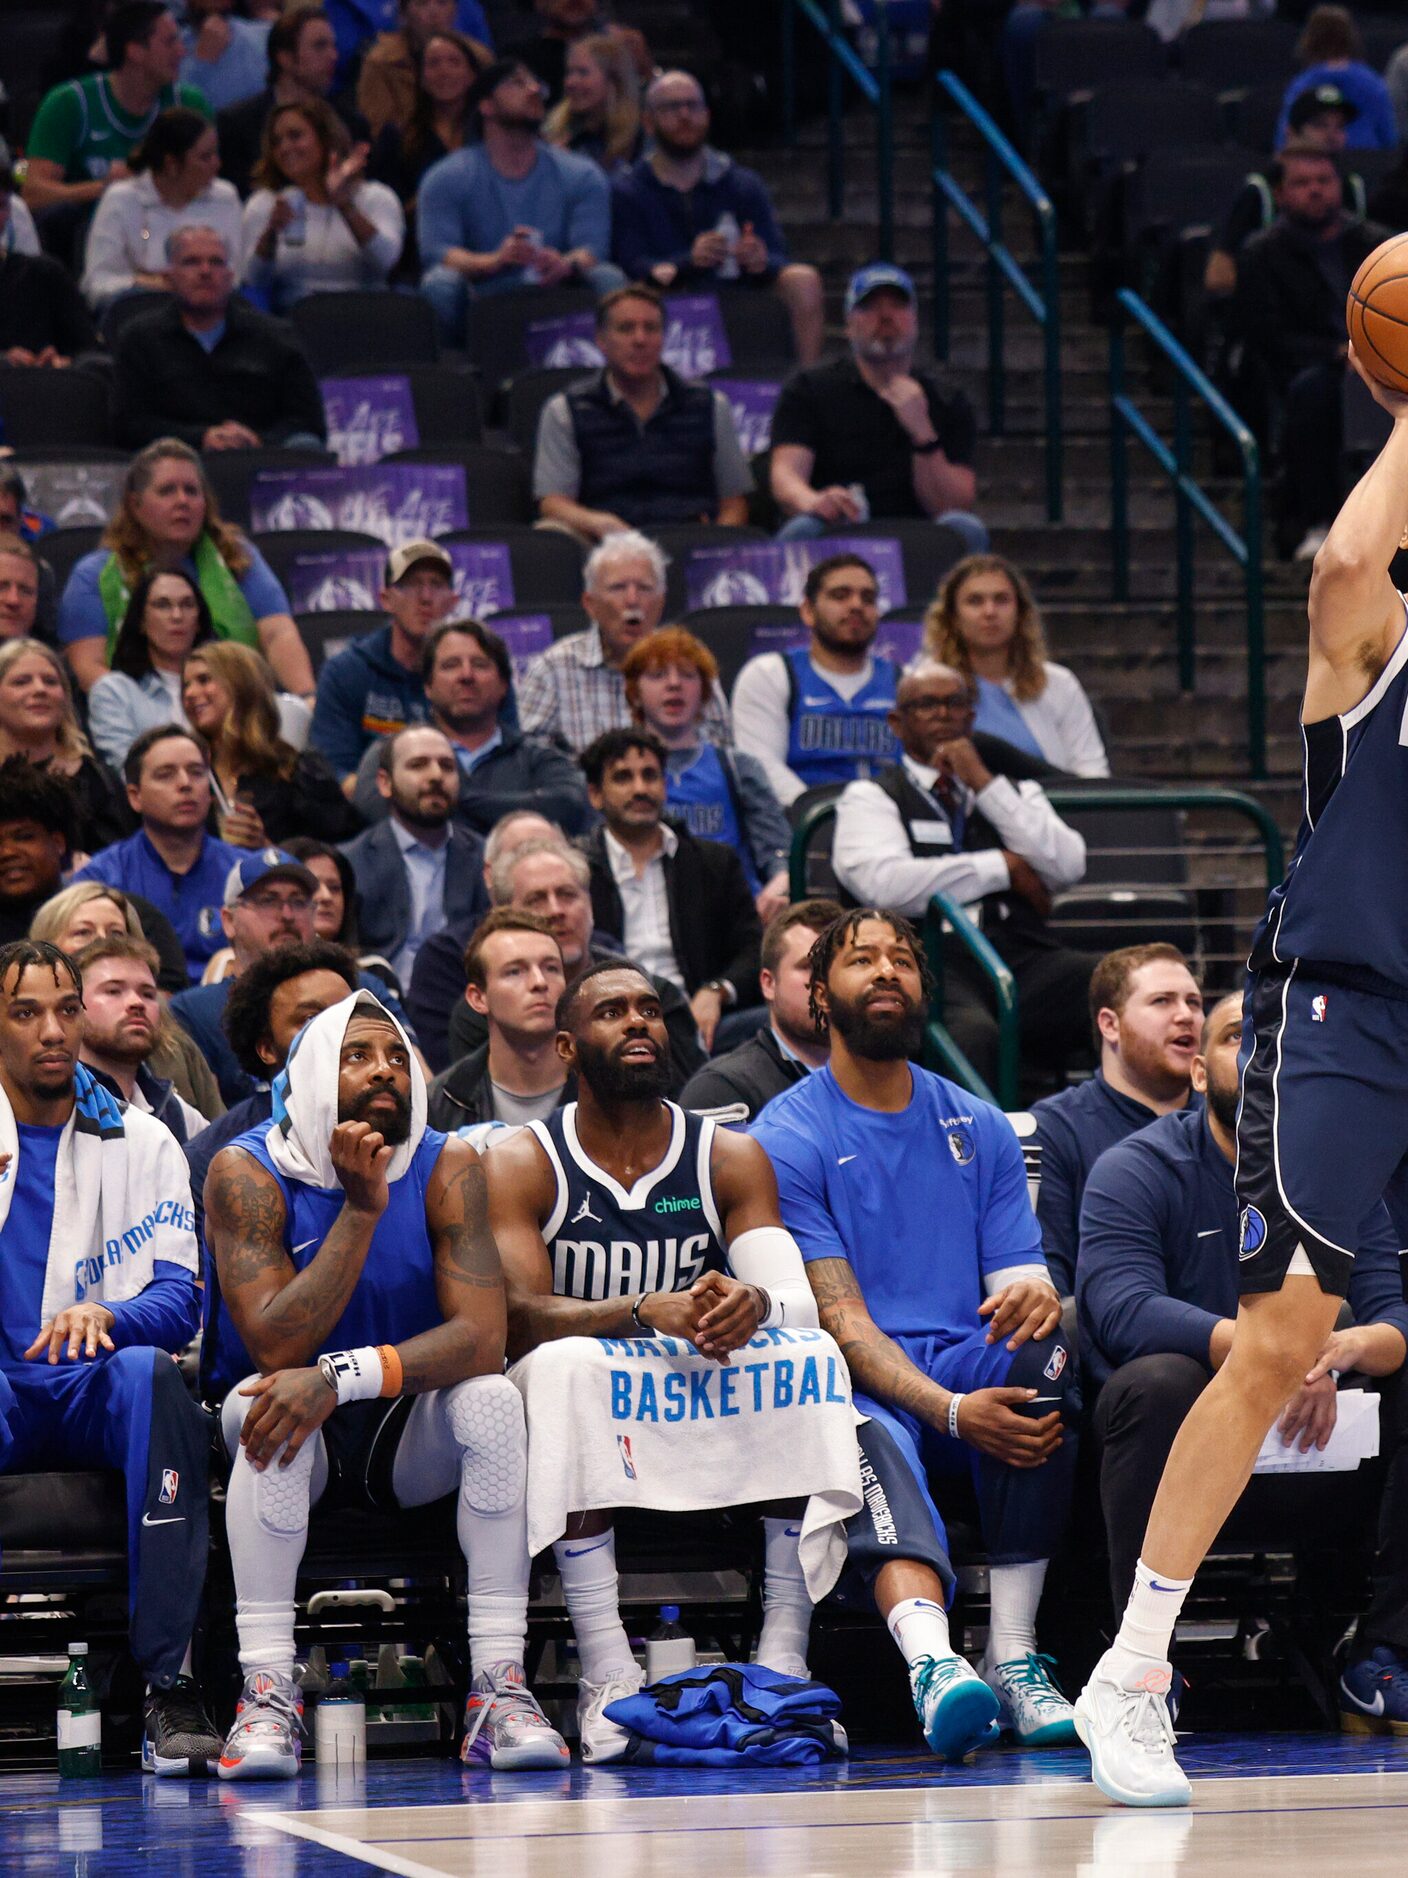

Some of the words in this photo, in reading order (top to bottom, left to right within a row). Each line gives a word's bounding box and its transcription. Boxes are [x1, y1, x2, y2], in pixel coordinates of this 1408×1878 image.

[654, 1196, 701, 1214] chime
[553, 1233, 710, 1300] MAVS
[610, 1356, 846, 1423] BASKETBAL
